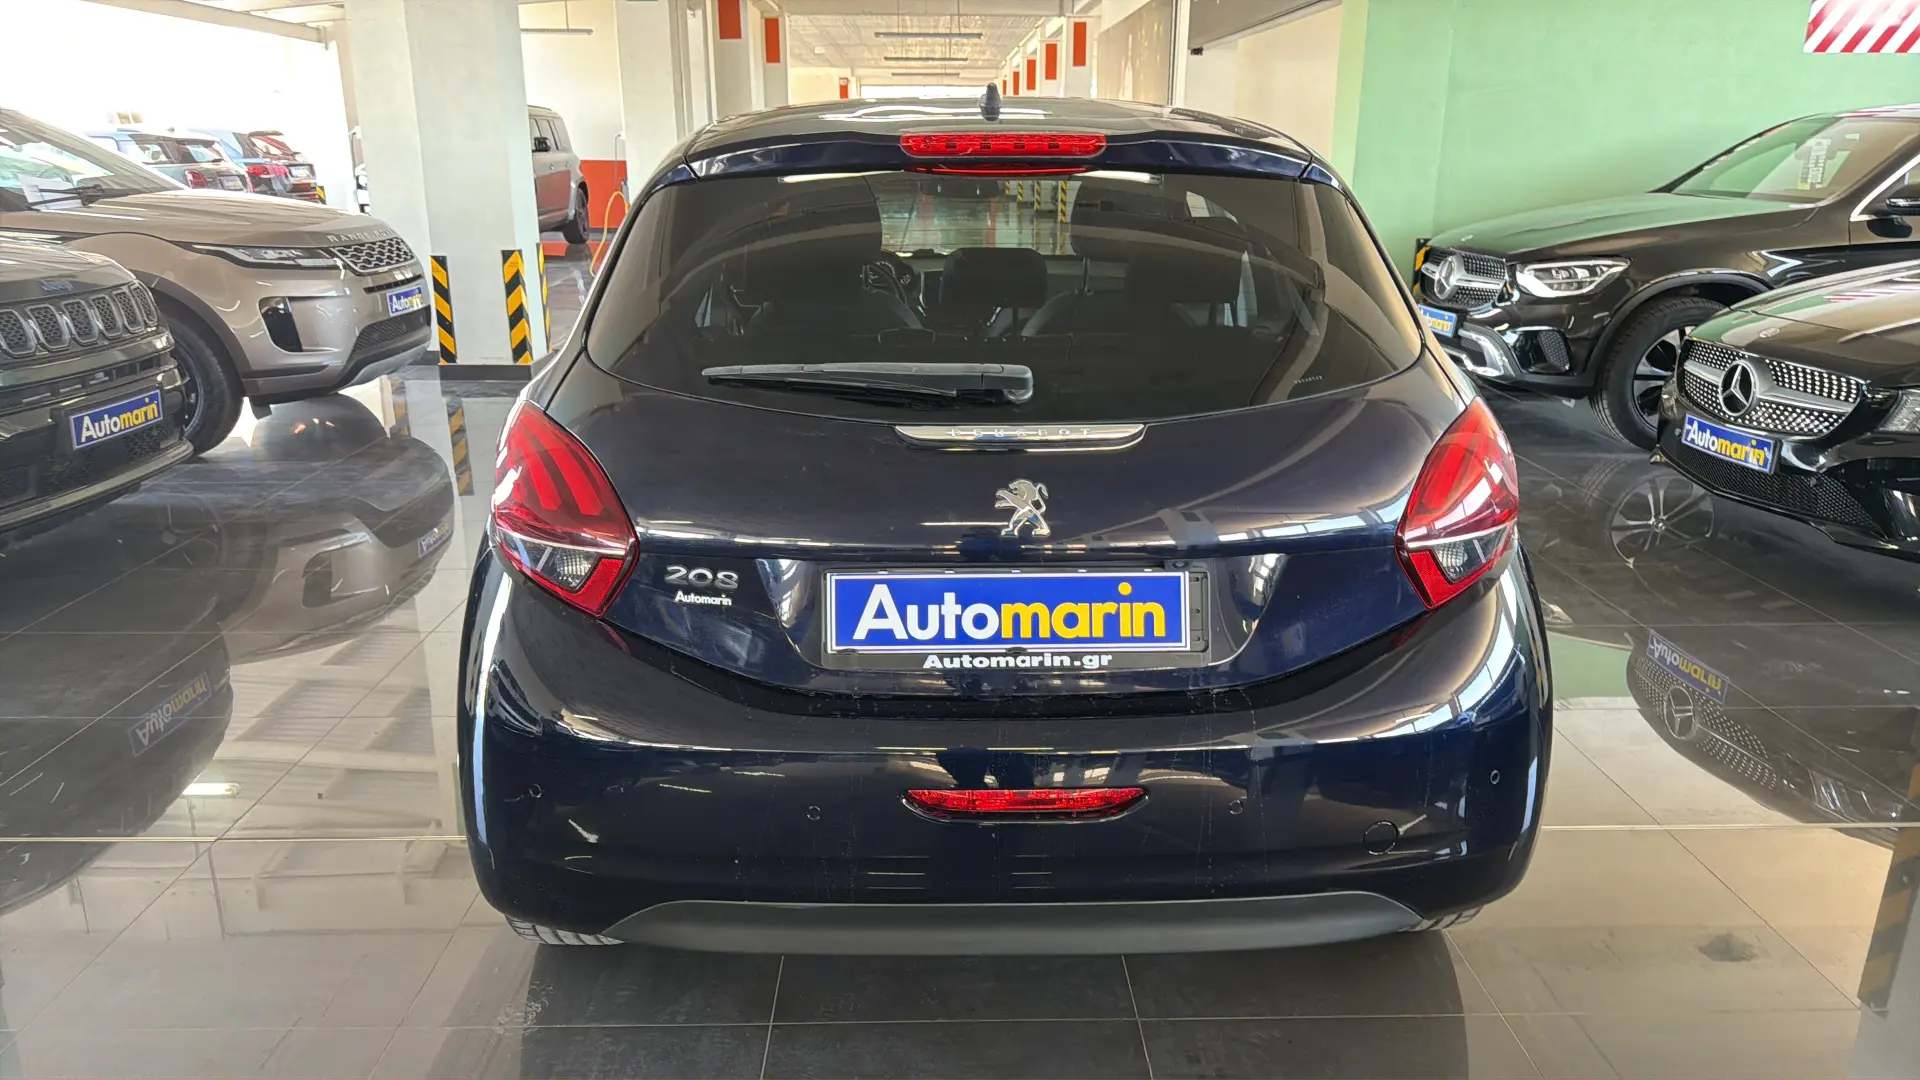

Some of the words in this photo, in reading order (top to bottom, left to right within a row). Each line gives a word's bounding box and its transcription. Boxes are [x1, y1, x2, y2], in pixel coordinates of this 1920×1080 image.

[327, 232, 371, 242] RANGE
[81, 397, 159, 443] Automarin
[1687, 420, 1765, 466] Automarin
[664, 565, 739, 589] 208
[674, 590, 733, 606] Automarin
[853, 582, 1166, 641] Automarin
[923, 653, 1113, 669] Automarin.gr
